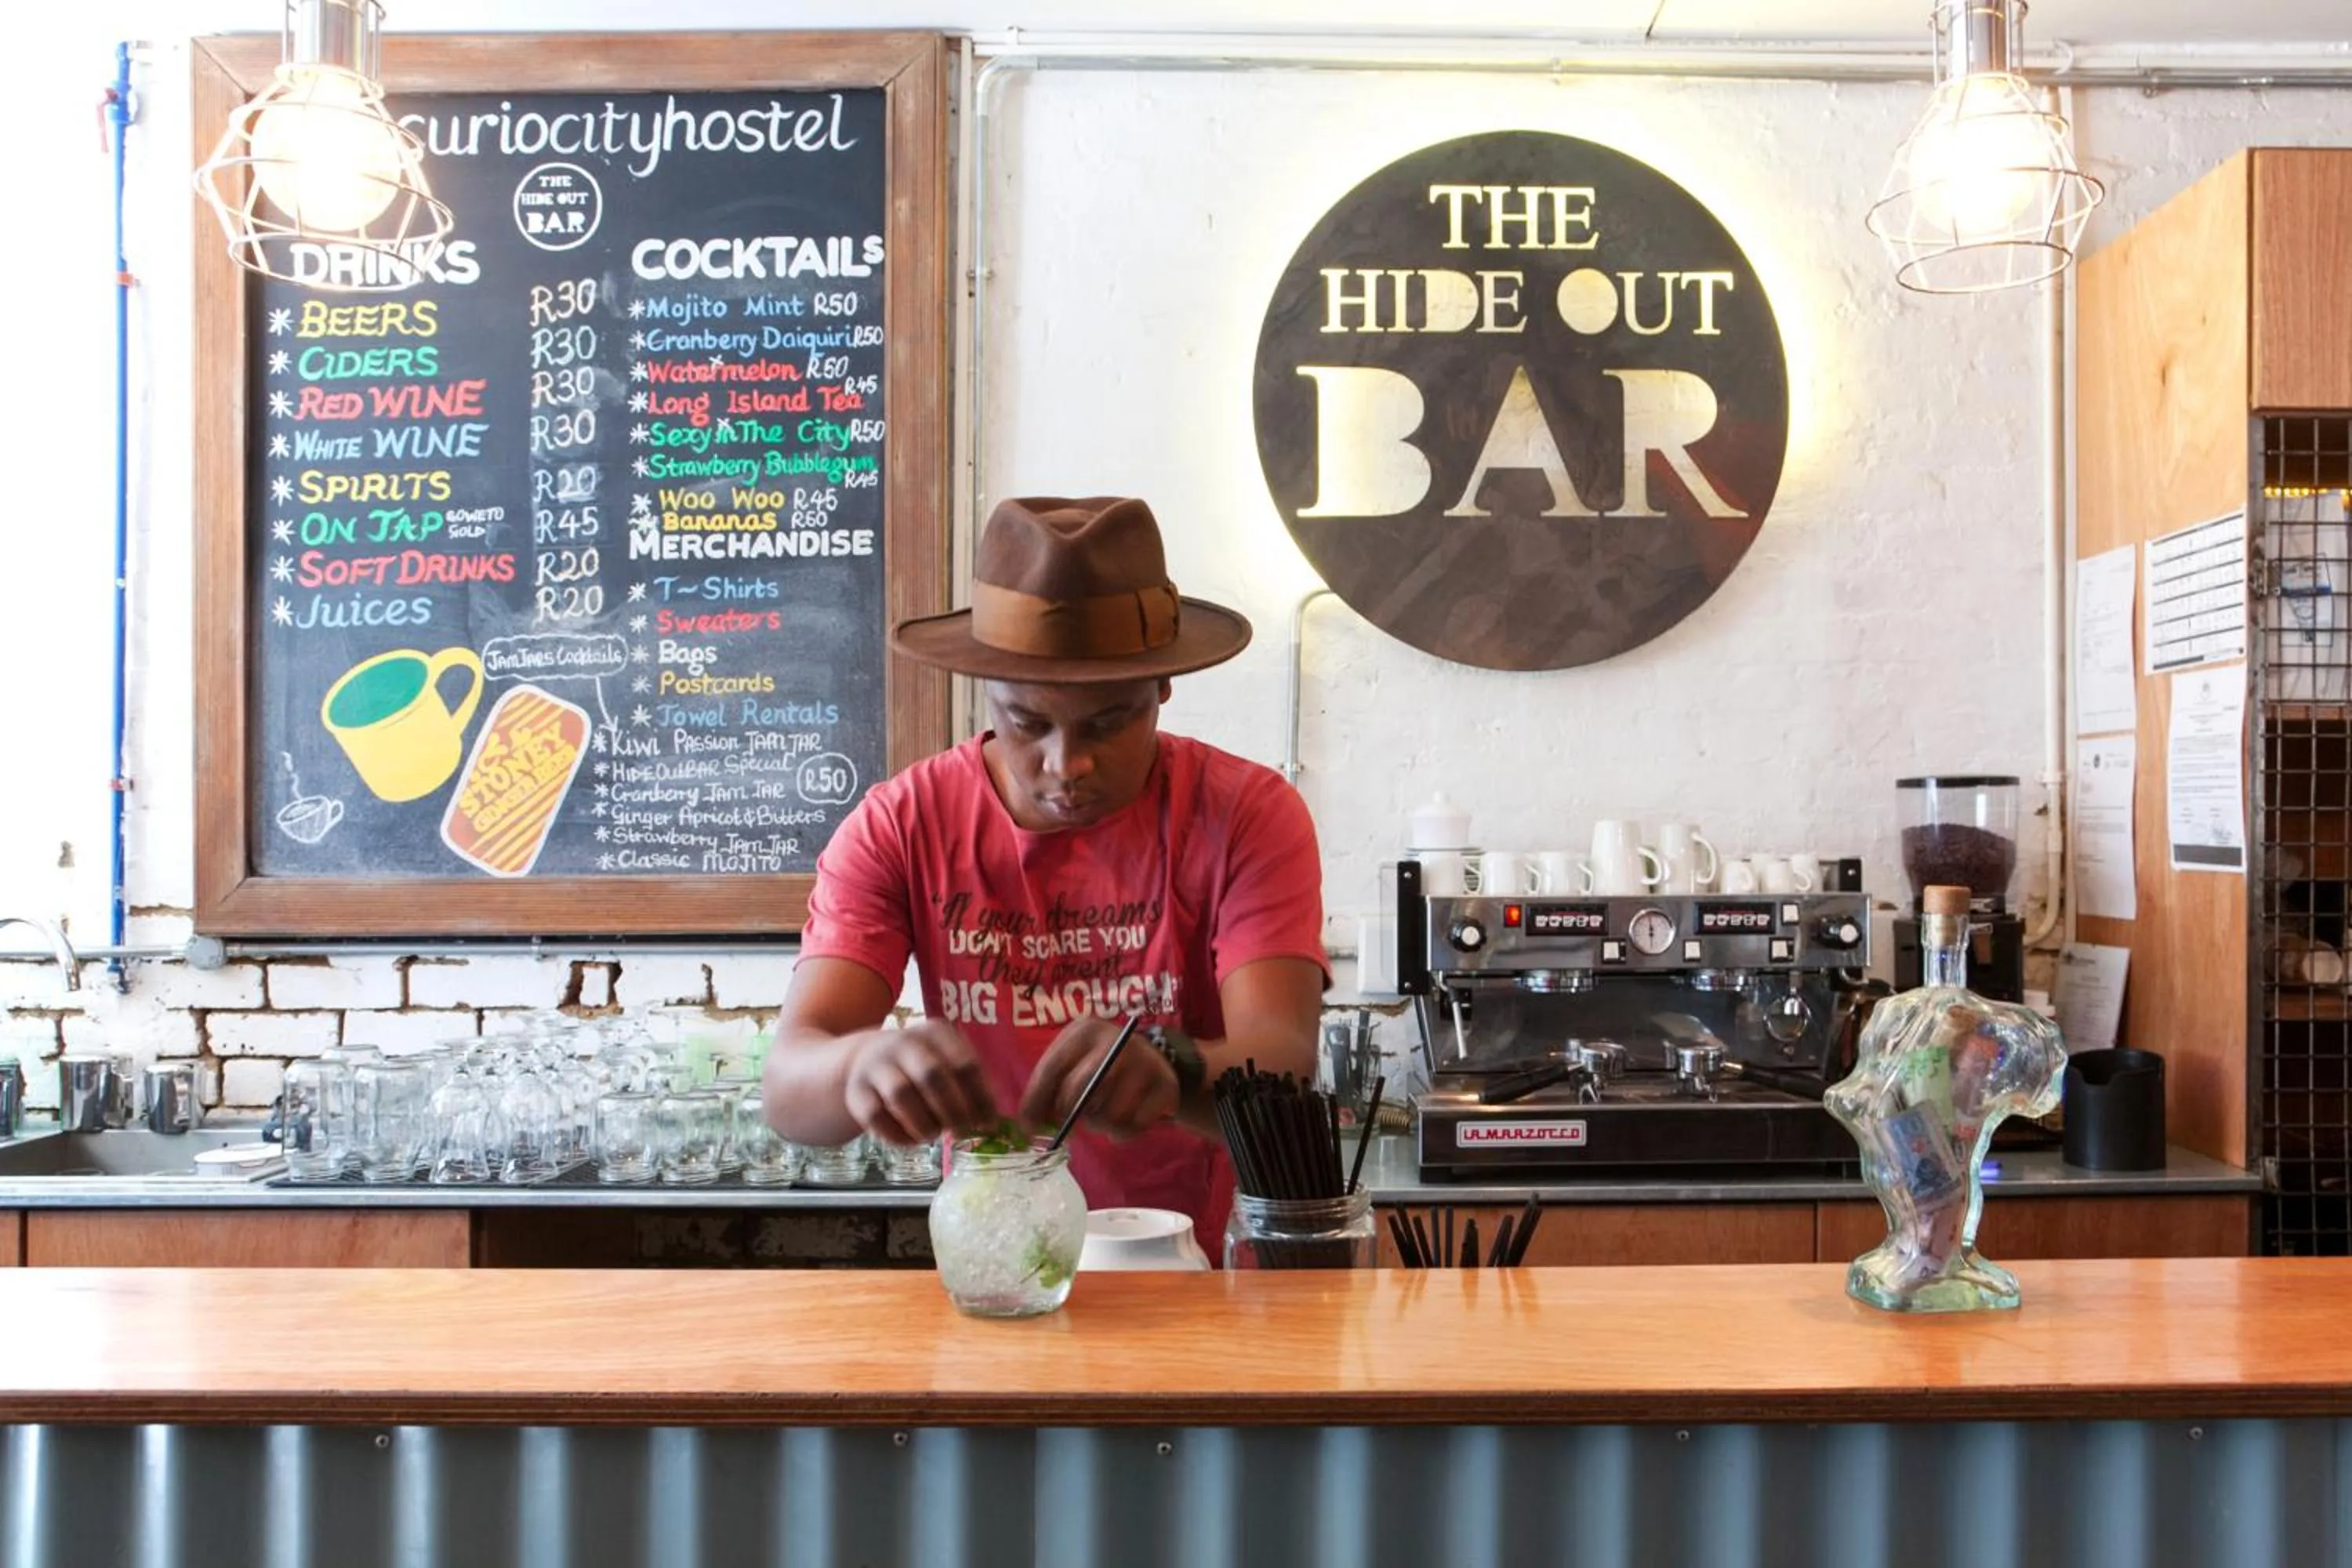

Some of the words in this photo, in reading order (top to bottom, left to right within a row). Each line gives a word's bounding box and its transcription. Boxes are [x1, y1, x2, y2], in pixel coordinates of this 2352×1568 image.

[520, 191, 554, 205] HIDE
[557, 192, 589, 205] OUT
[539, 175, 573, 187] THE
[526, 211, 586, 233] BAR
[1429, 184, 1599, 249] THE
[289, 240, 481, 285] DRINKS
[632, 234, 885, 280] COCKTAILS
[296, 299, 438, 339] BEERS
[530, 278, 597, 327] R30
[646, 294, 728, 326] Mojito
[743, 293, 805, 316] Mint
[813, 292, 858, 316] R50
[1319, 267, 1528, 333] HIDE
[1556, 267, 1734, 336] OUT
[298, 345, 438, 380] CIDERS
[531, 325, 597, 369] R30
[645, 327, 757, 358] Cranberry
[761, 325, 855, 358] Daiquiri
[853, 325, 884, 349] R50
[648, 357, 801, 383] Watermelon
[806, 355, 849, 379] R50
[293, 387, 363, 420] RED
[368, 379, 488, 418] WINE
[531, 366, 597, 408] R30
[648, 390, 711, 428] Long
[728, 386, 811, 414] Island
[816, 386, 865, 412] Tea
[844, 375, 878, 395] R45
[292, 429, 362, 461] WHITE
[371, 423, 489, 459] WINE
[531, 408, 597, 452] R30
[649, 421, 713, 454] Sexy
[735, 419, 785, 445] The
[797, 417, 852, 452] City
[850, 419, 885, 443] R50
[1296, 365, 1749, 517] BAR
[298, 470, 452, 504] SPIRITS
[533, 466, 599, 503] R20
[648, 453, 762, 488] Strawberry
[765, 450, 878, 484] Bubblegum
[844, 469, 879, 488] R45
[659, 488, 716, 510] Woo
[731, 487, 786, 510] Woo
[793, 487, 838, 511] R45
[300, 512, 357, 545] ON
[534, 506, 600, 544] R45
[662, 511, 778, 532] Bananas
[629, 529, 875, 561] MERCHANDISE
[298, 550, 396, 587] SOFT
[396, 550, 515, 585] DRINKS
[535, 547, 600, 586] R20
[295, 591, 433, 630] Juices
[533, 585, 604, 626] R20
[657, 608, 782, 636] Sweaters
[658, 639, 718, 676] Bags
[659, 670, 775, 696] Postcards
[656, 703, 728, 728] Towel
[740, 698, 839, 726] Rentals
[458, 720, 567, 818] STONEY
[805, 767, 847, 793] R50
[611, 783, 699, 807] Cranberry
[611, 803, 672, 829] Ginger
[613, 828, 717, 854] Strawberry
[618, 848, 690, 868] Classic
[1051, 891, 1163, 928] dreams
[1022, 929, 1092, 960] SCARE
[1099, 925, 1146, 951] YOU
[941, 978, 997, 1025] BIG
[1464, 1128, 1480, 1141] LA
